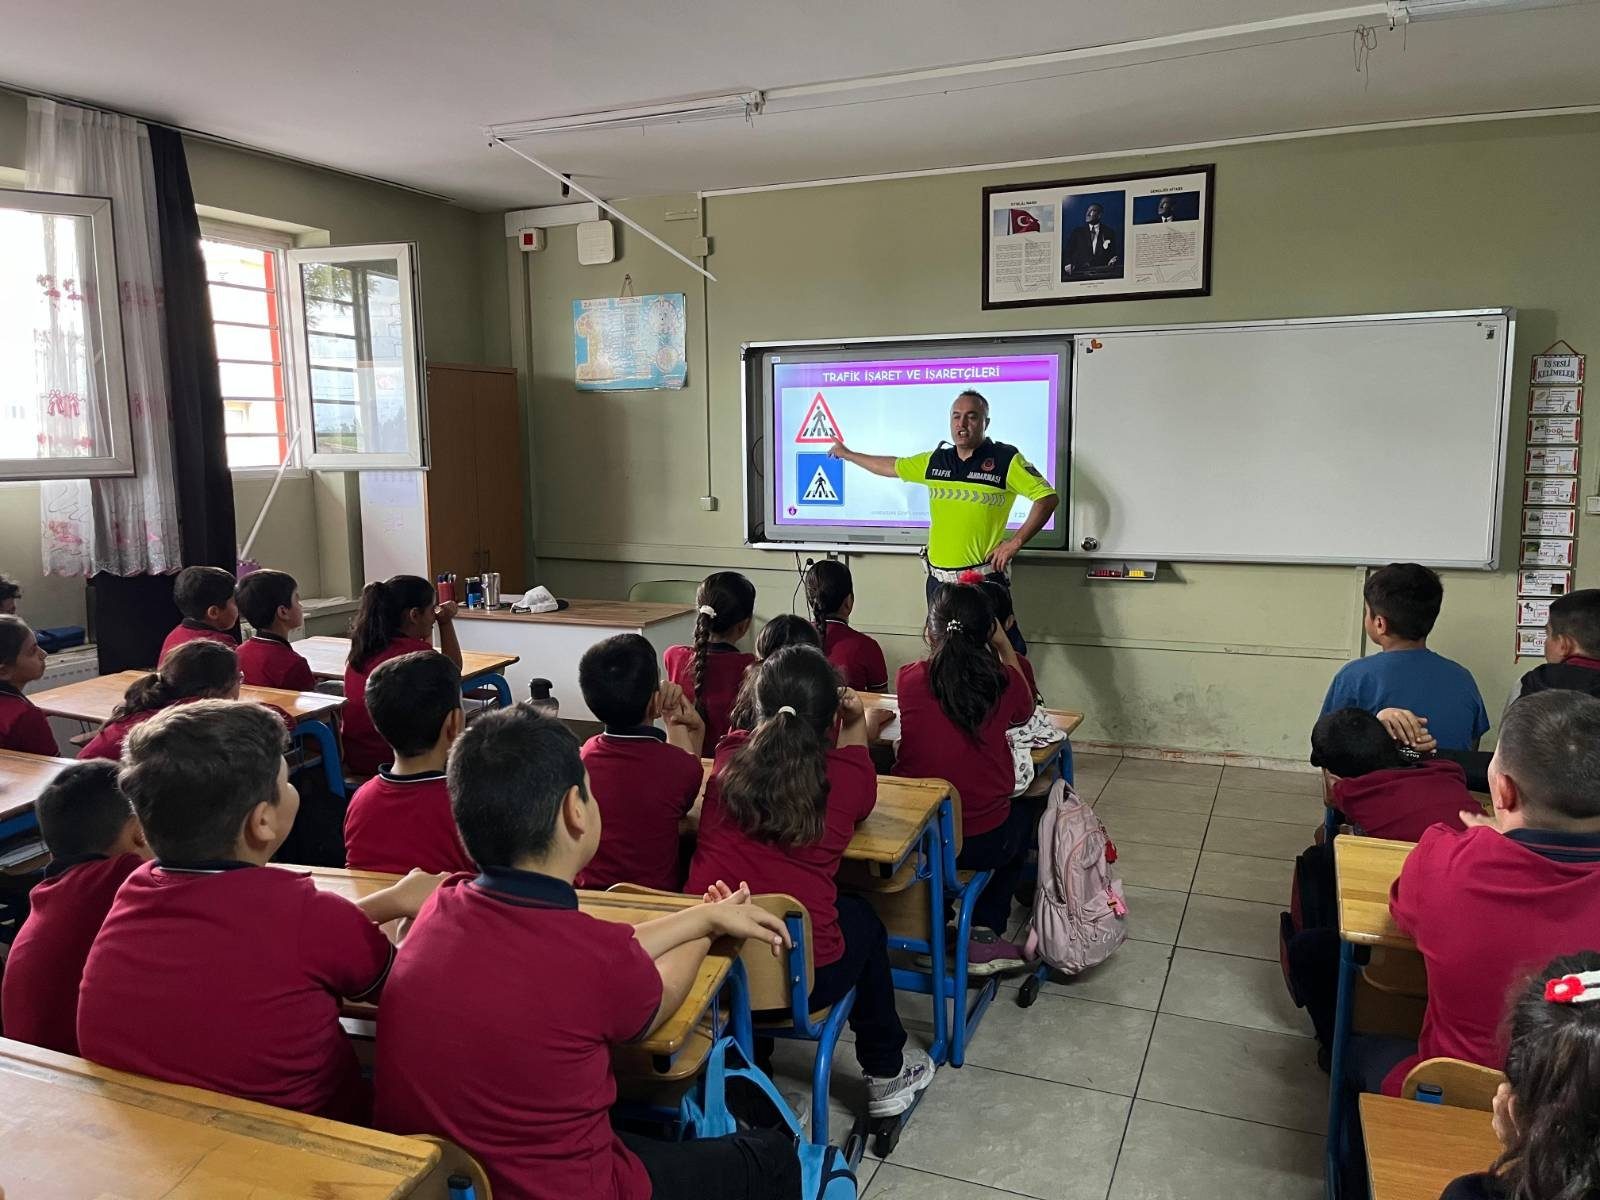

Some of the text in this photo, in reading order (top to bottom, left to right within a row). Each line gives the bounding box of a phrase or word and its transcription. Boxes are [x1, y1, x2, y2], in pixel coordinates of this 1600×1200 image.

[822, 365, 1000, 384] TRAFİK İŞARET VE İŞARETÇİLERİ
